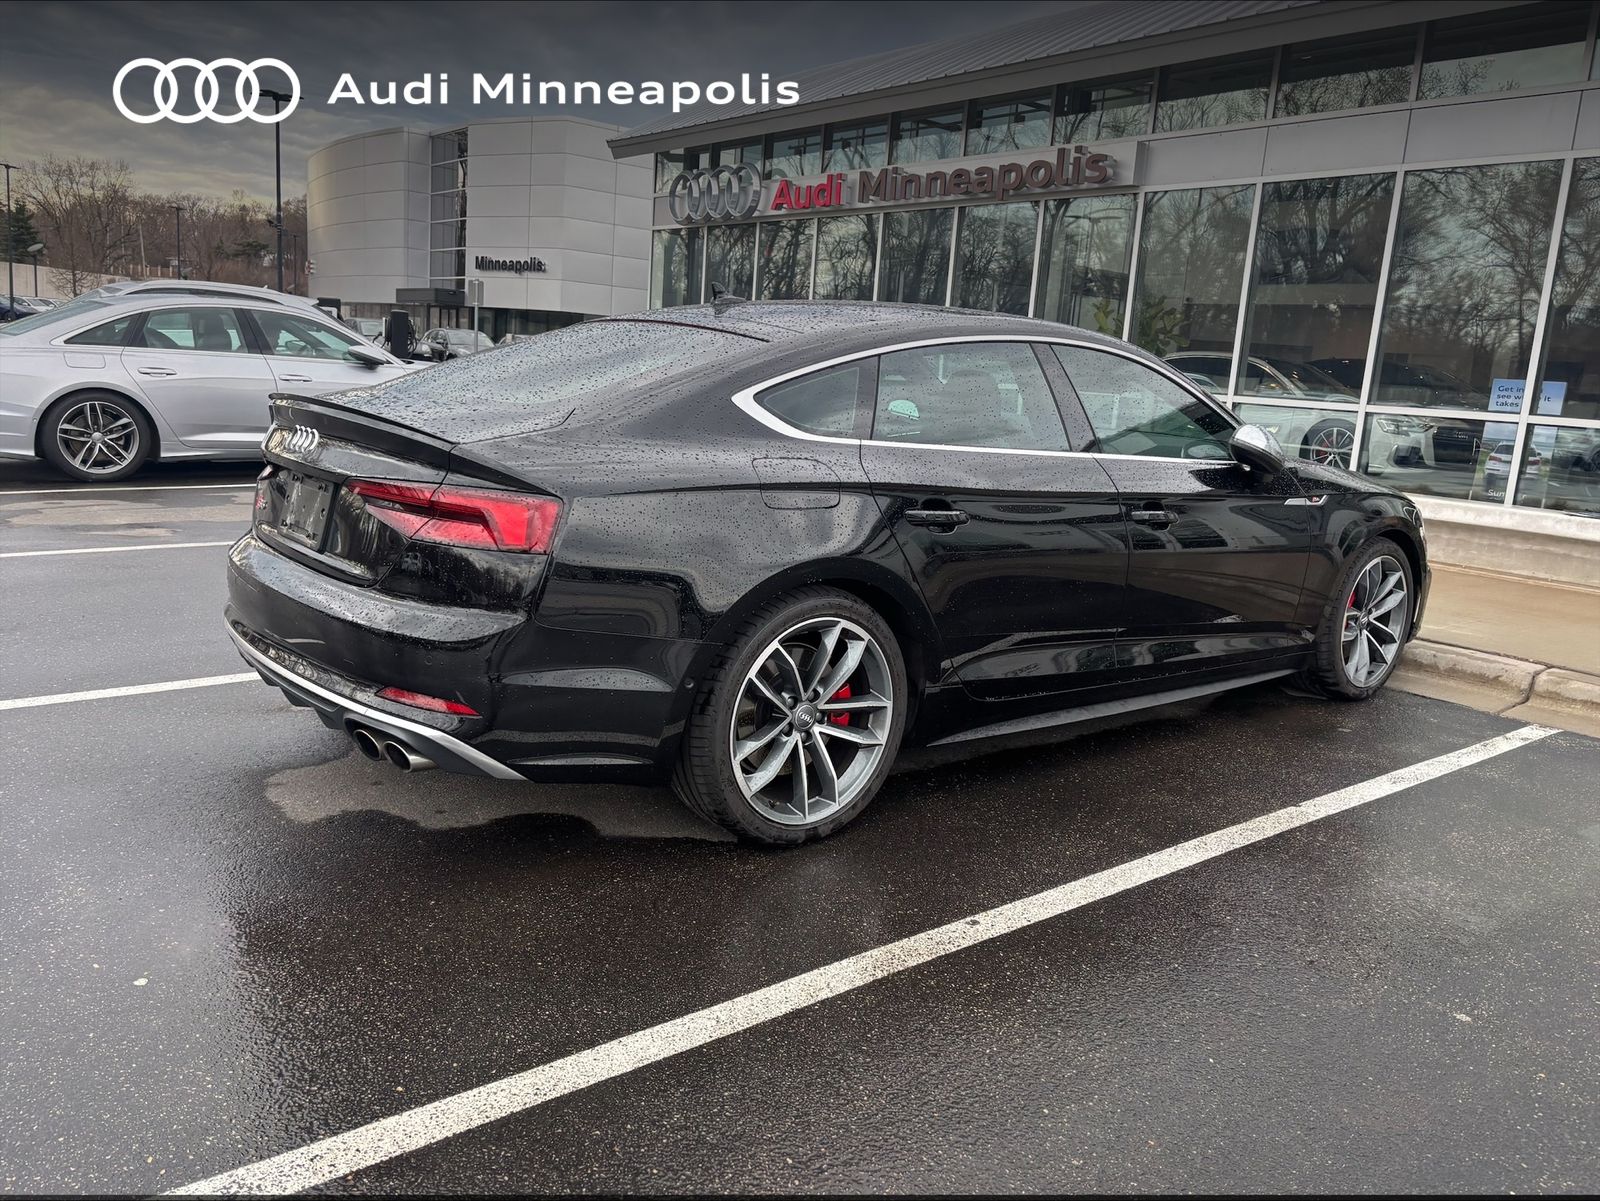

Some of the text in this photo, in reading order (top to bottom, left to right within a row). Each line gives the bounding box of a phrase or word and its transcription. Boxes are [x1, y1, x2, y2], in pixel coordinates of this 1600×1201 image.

[770, 145, 1112, 211] Audi Minneapolis
[475, 255, 546, 274] Minneapolis
[1497, 385, 1514, 393] Get
[1495, 400, 1519, 408] takes
